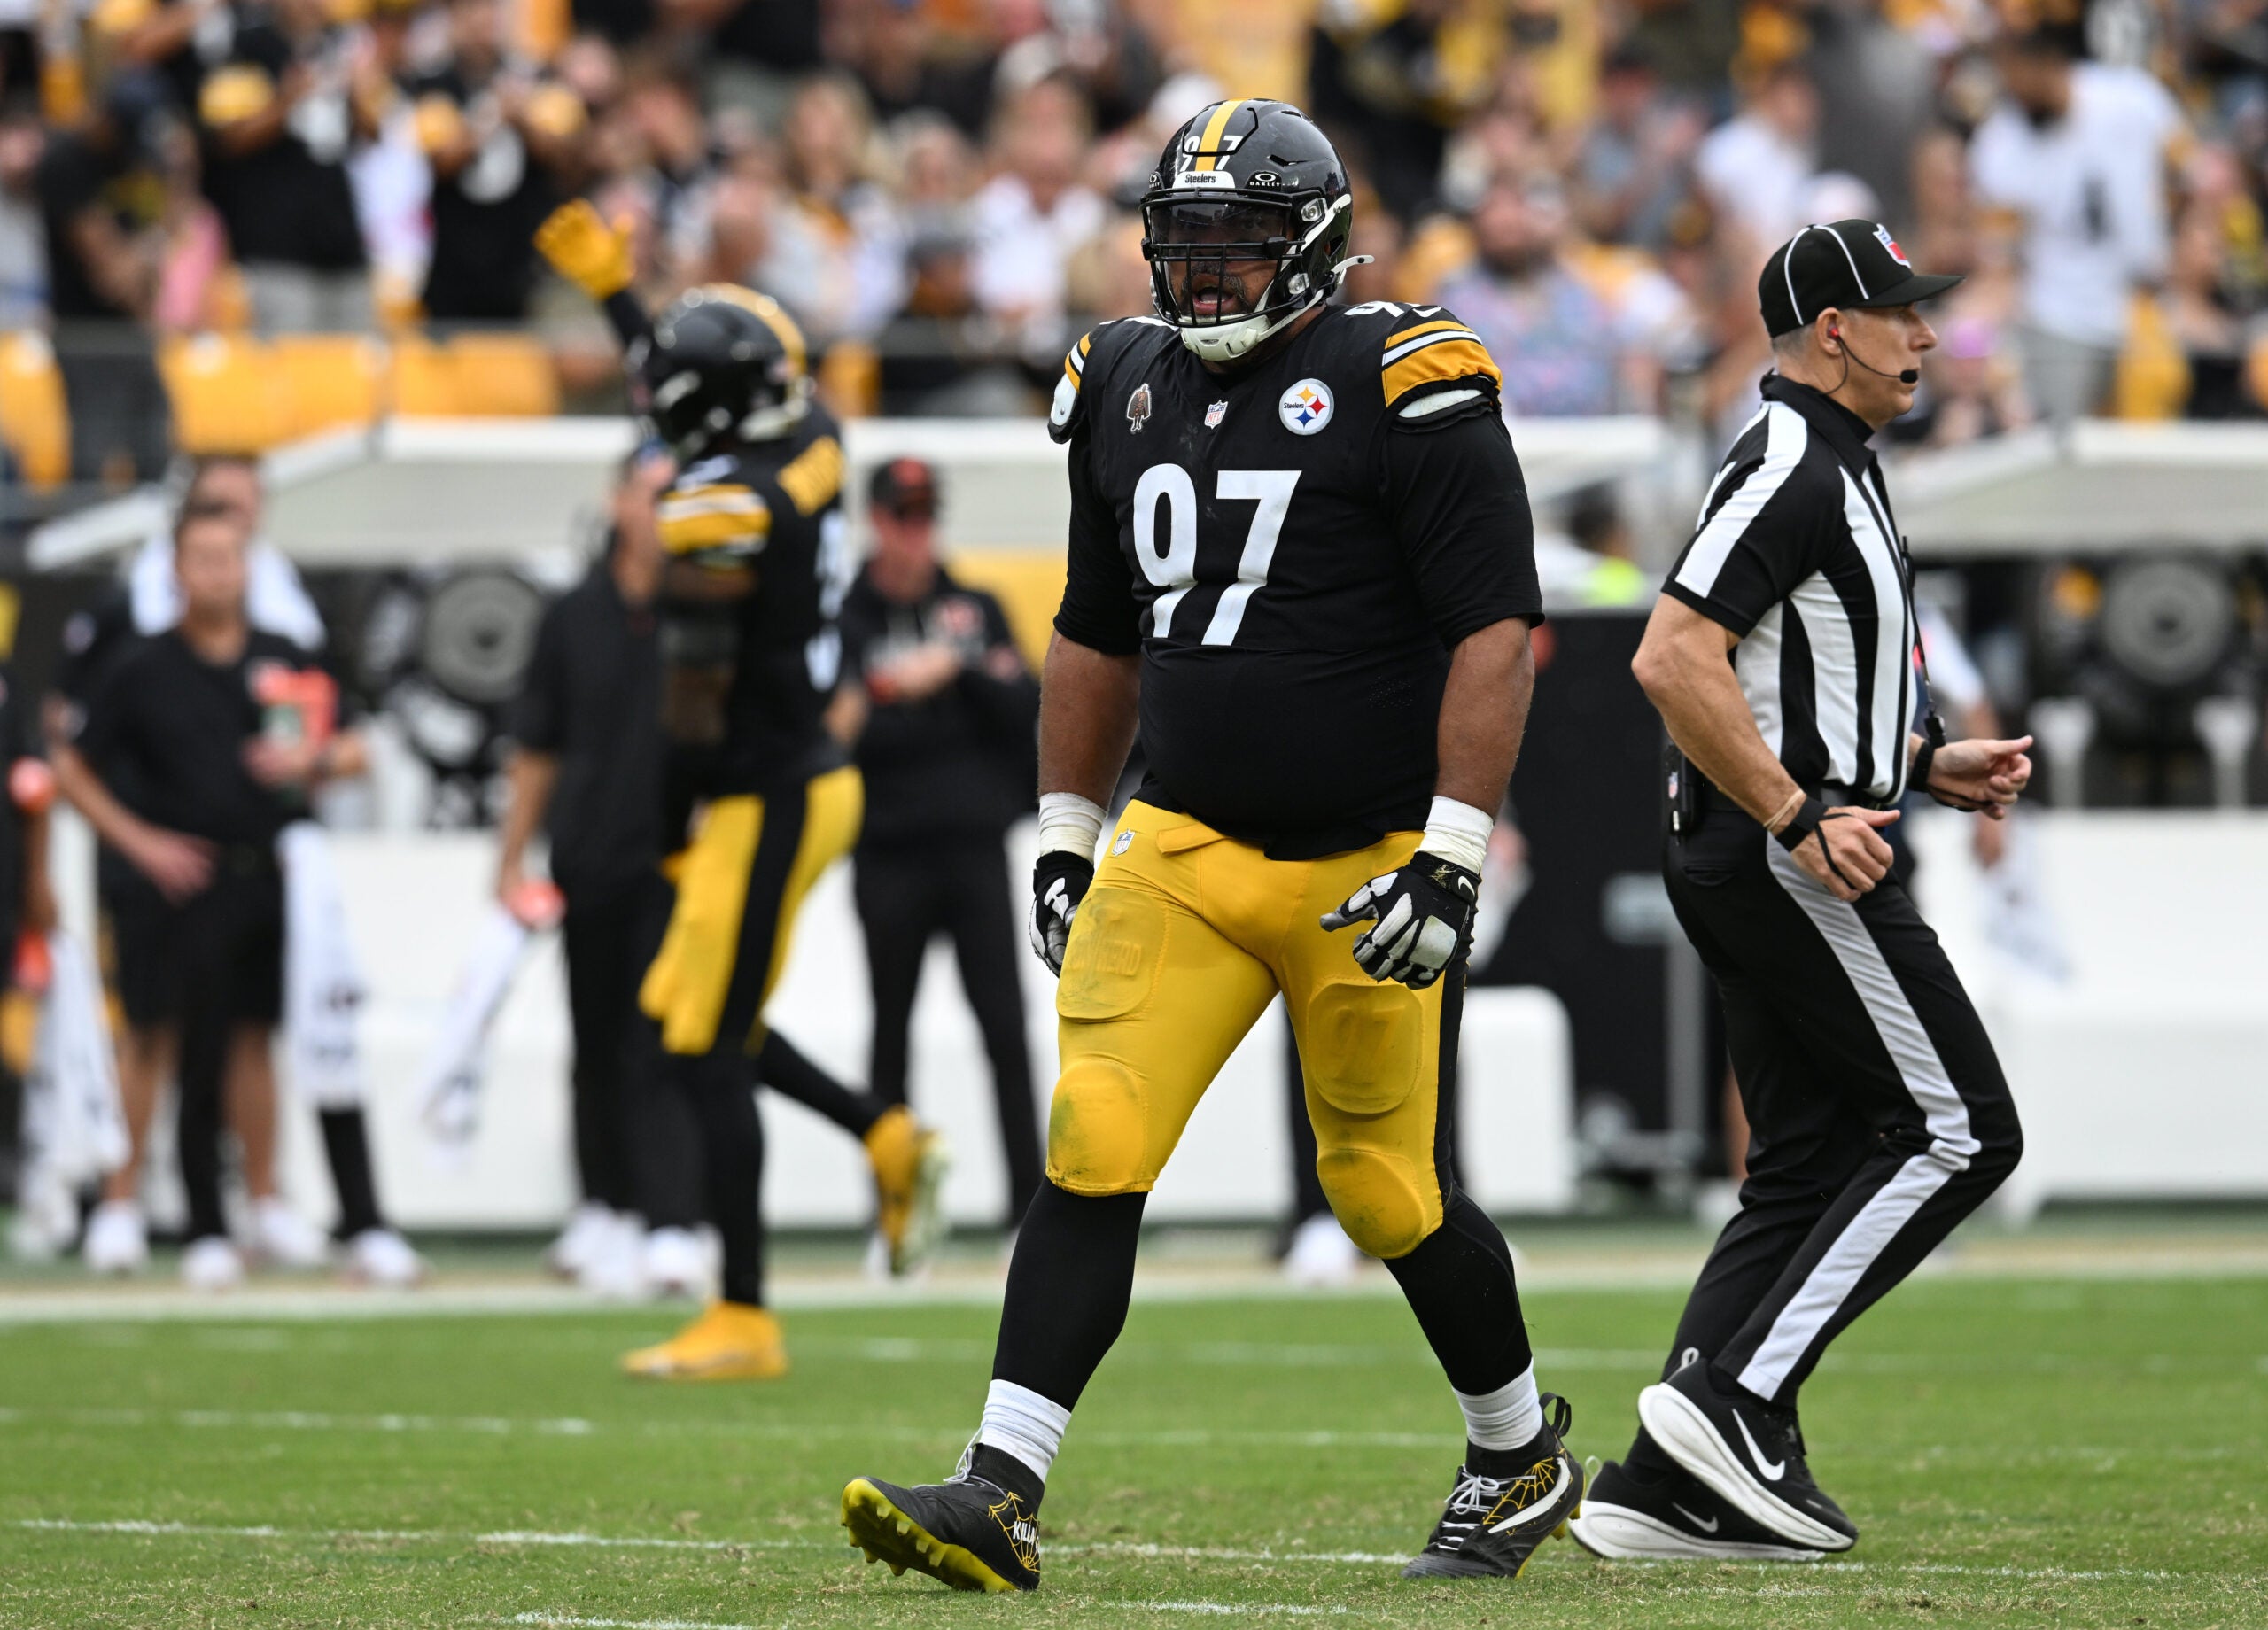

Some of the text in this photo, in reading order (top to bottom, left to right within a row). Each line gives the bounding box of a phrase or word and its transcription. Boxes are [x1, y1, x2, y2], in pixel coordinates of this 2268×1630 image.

[1184, 174, 1216, 183] Steelers
[1133, 463, 1302, 646] 97
[1013, 1521, 1035, 1545] KILLA
